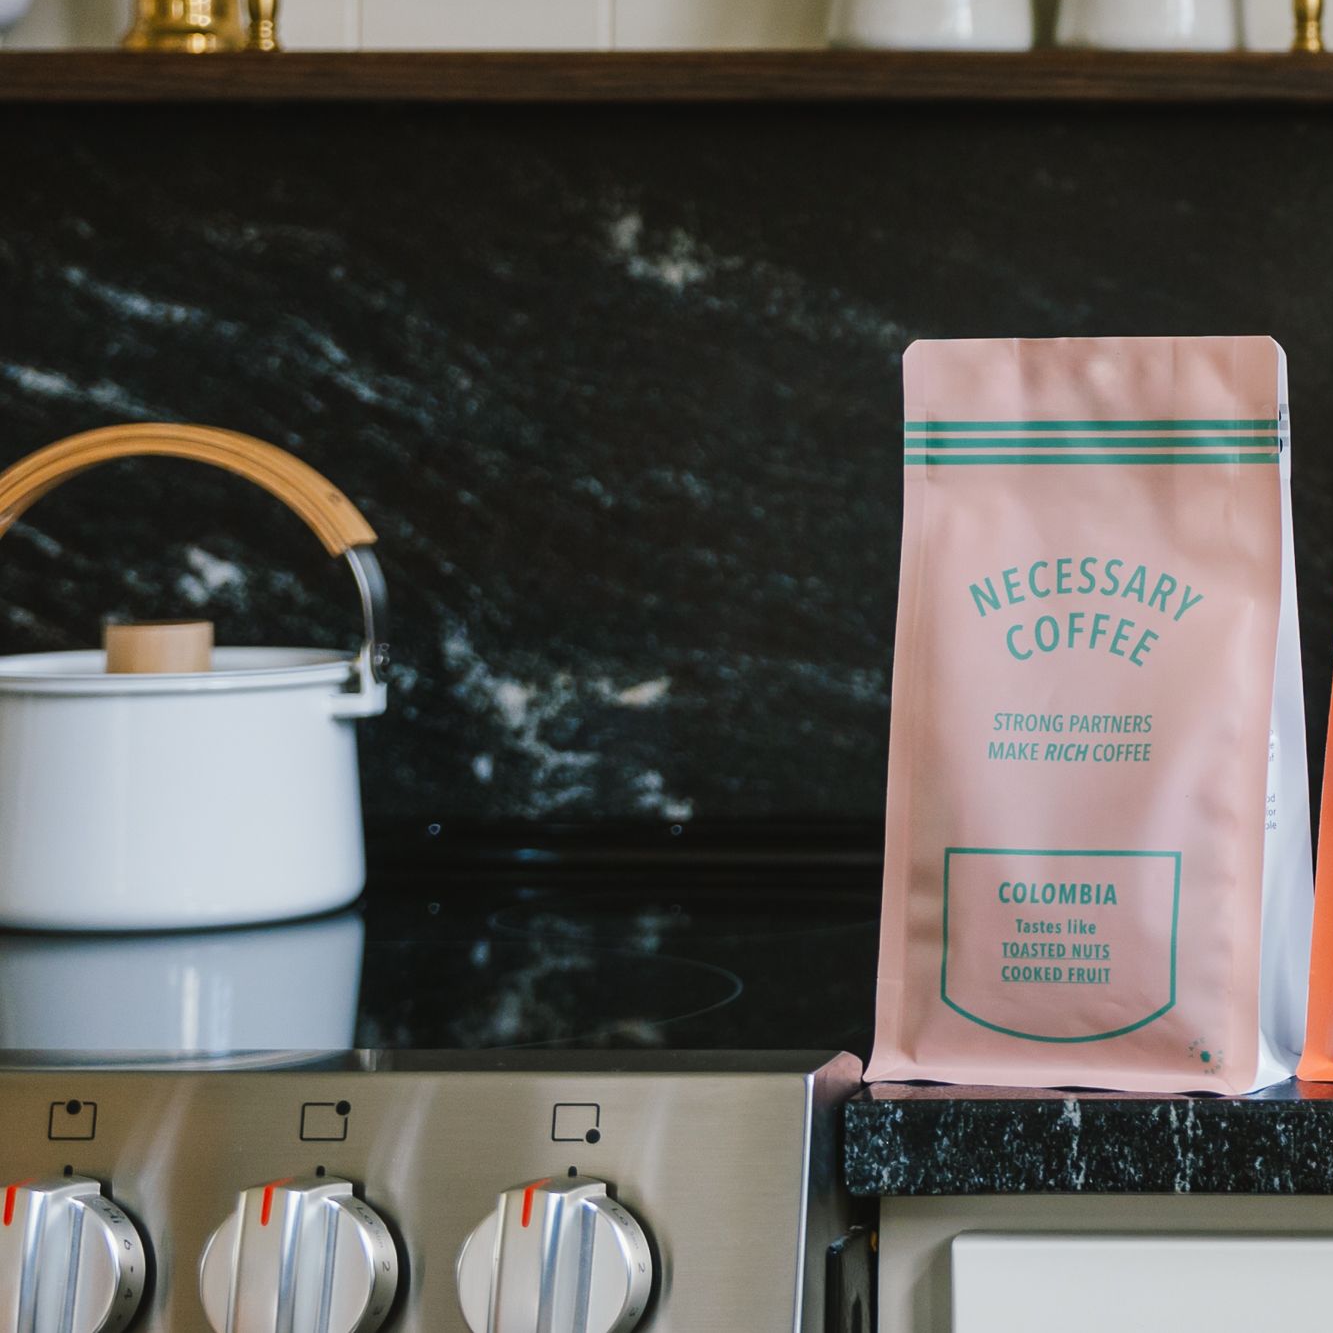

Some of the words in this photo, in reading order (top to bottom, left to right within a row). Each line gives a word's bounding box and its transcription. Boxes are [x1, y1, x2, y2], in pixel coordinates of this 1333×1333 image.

[969, 557, 1202, 622] NECESSARY
[1007, 613, 1159, 666] COFFEE
[994, 713, 1063, 732] STRONG
[1070, 715, 1152, 733] PARTNERS
[989, 742, 1039, 760] MAKE
[1045, 744, 1088, 761] RICH
[1093, 744, 1152, 762] COFFEE
[999, 882, 1117, 905] COLOMBIA
[1016, 919, 1061, 933] Tastes
[1068, 919, 1096, 934] like
[1002, 942, 1065, 958] TOASTED
[1073, 944, 1109, 960] NUTS
[1002, 966, 1062, 982] COOKED
[1068, 968, 1110, 983] FRUIT
[382, 1261, 391, 1272] 2
[638, 1262, 646, 1273] 2
